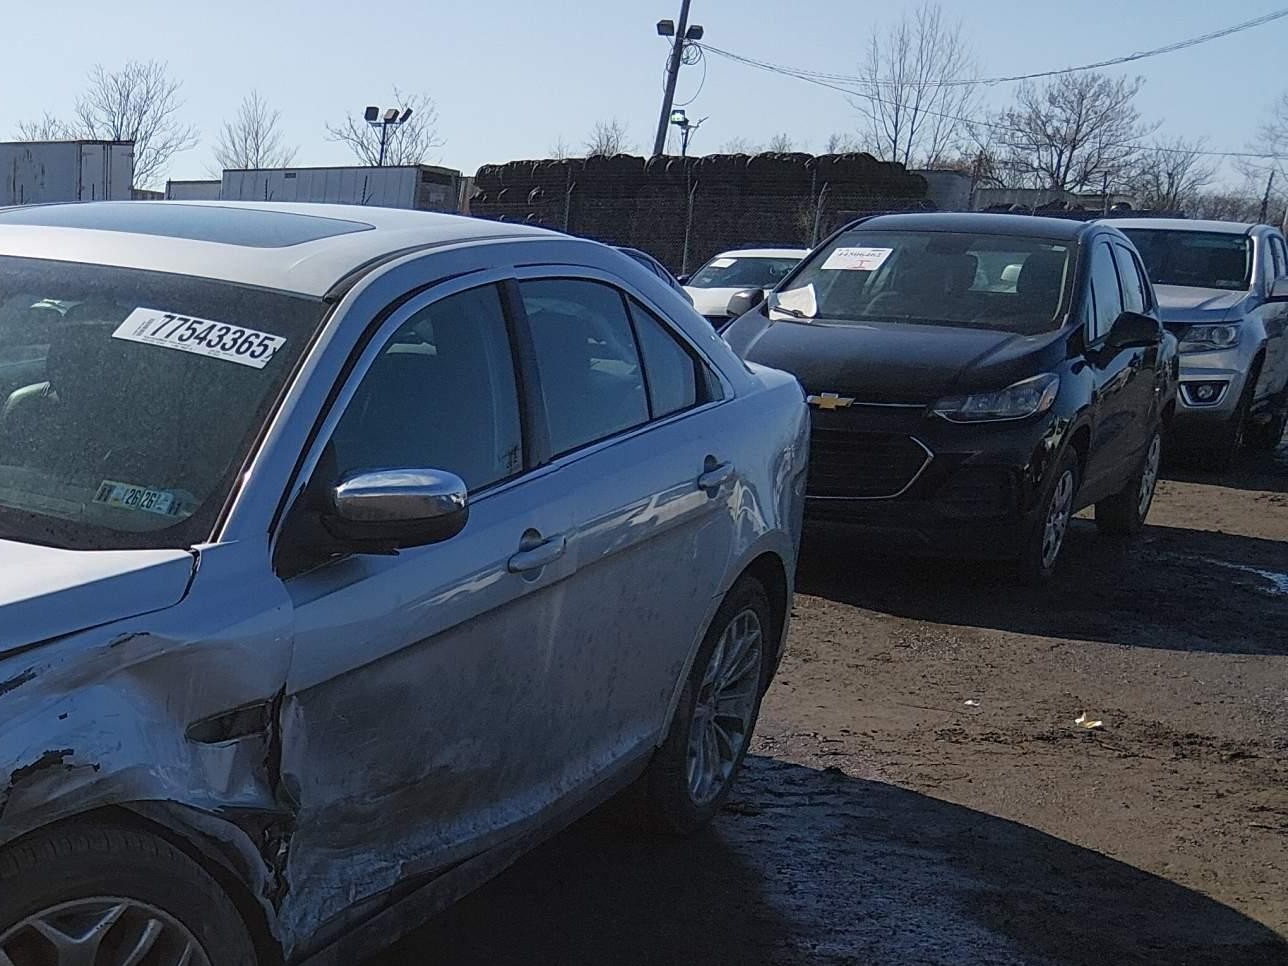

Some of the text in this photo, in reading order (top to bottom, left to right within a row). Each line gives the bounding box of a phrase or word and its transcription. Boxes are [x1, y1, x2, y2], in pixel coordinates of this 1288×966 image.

[150, 314, 275, 360] 77543365
[125, 488, 141, 506] 26
[140, 491, 158, 510] 26
